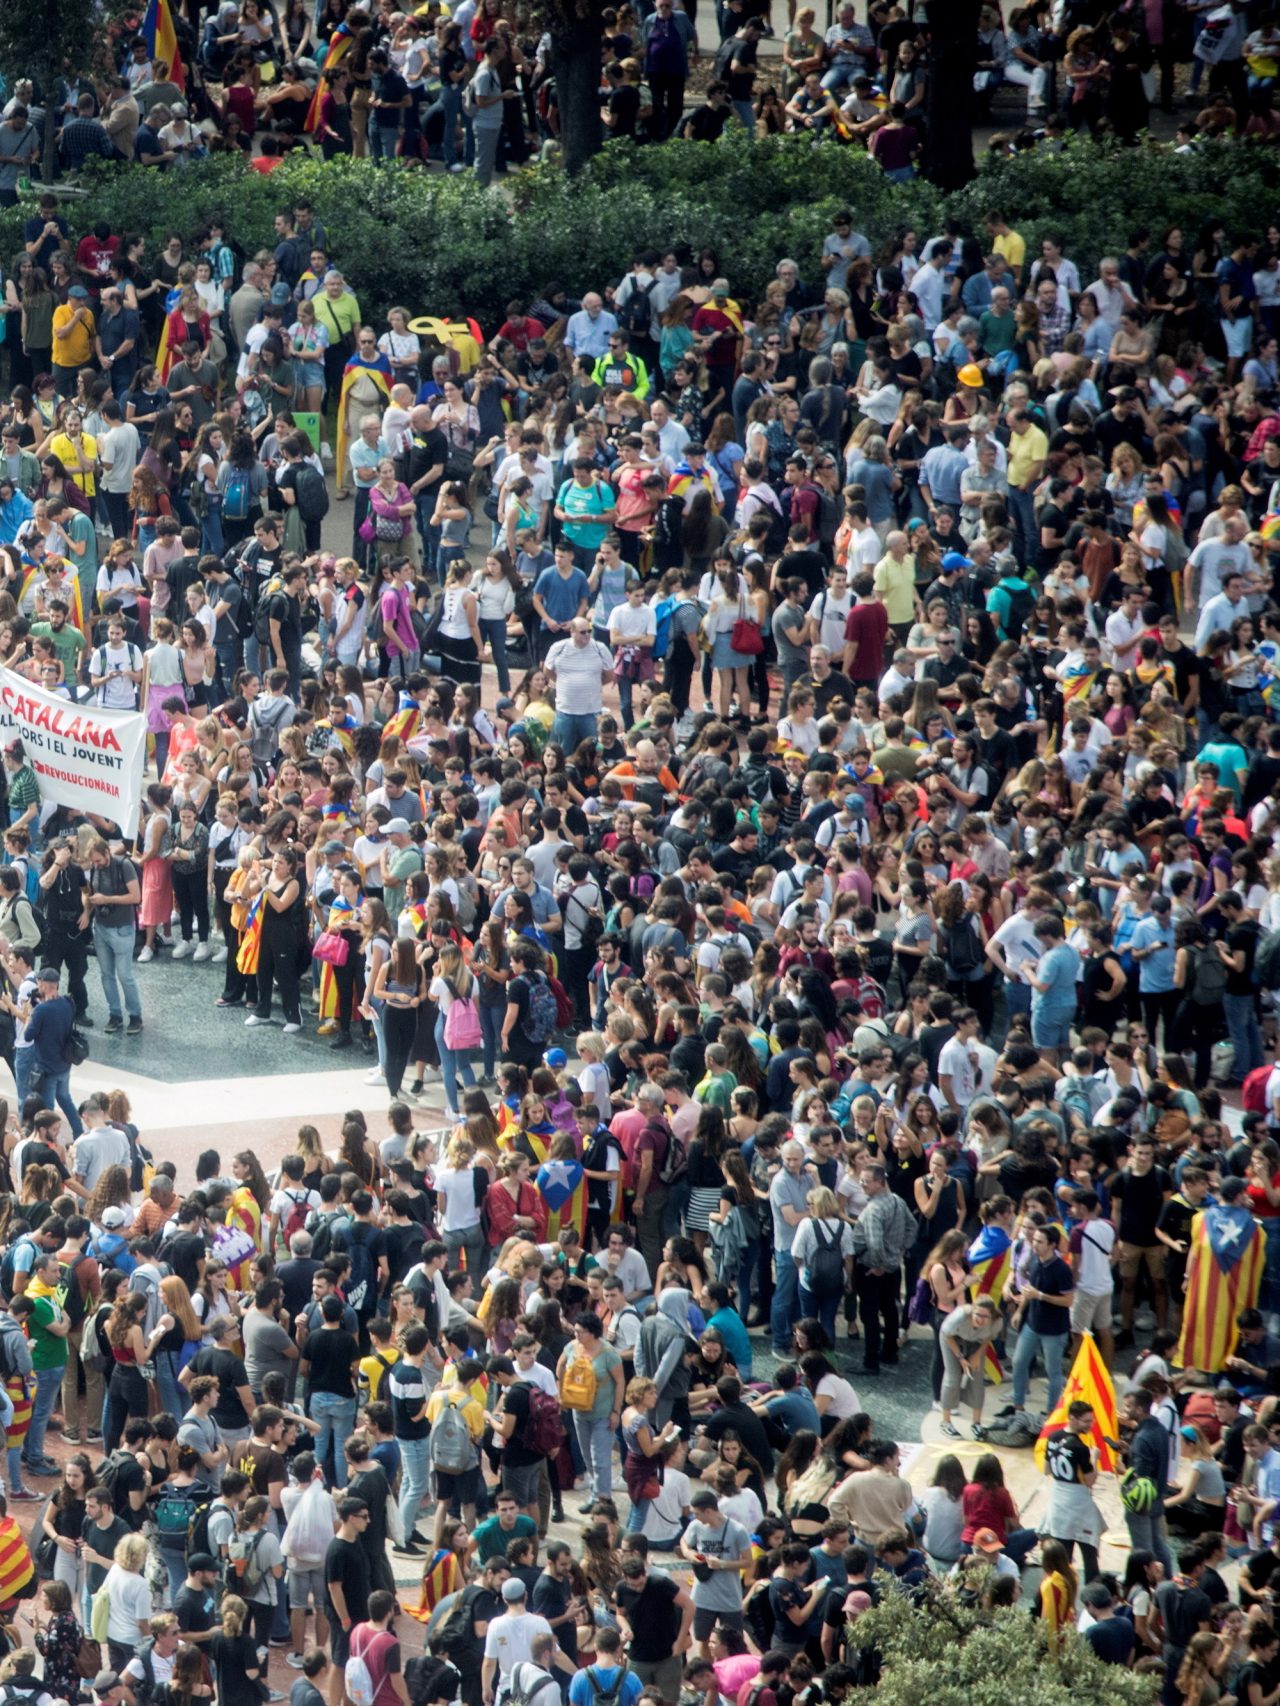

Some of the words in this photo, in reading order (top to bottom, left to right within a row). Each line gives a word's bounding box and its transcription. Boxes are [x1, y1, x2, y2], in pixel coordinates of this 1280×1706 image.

[1, 686, 122, 752] CATALANA
[47, 738, 51, 750] I
[54, 740, 66, 756] EL
[73, 746, 123, 770] JOVENT
[1050, 1454, 1074, 1481] 10
